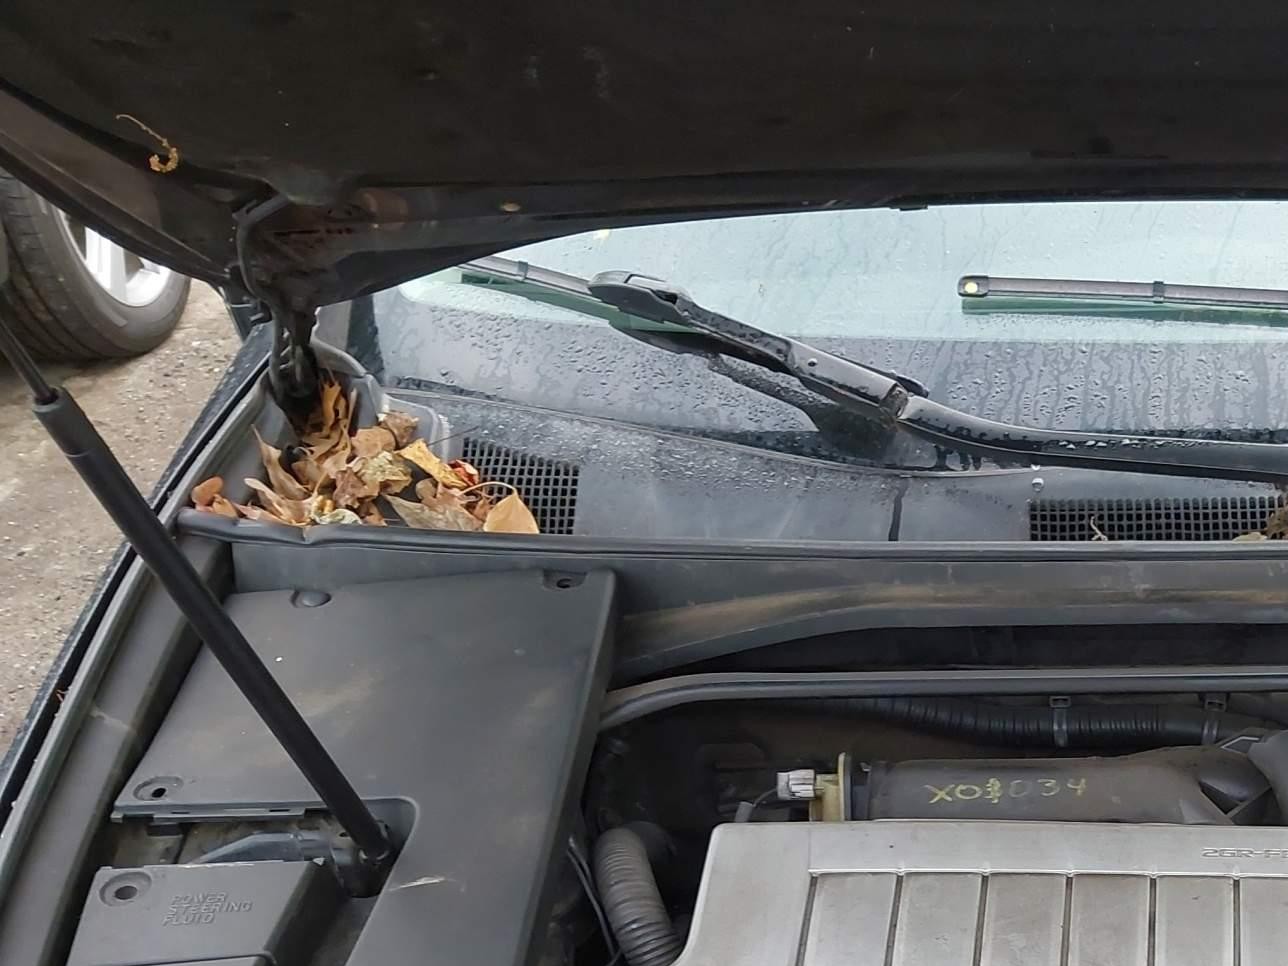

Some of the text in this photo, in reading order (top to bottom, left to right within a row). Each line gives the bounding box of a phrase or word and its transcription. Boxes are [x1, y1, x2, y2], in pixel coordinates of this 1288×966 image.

[169, 892, 228, 905] POWER
[167, 901, 253, 915] STEERING
[162, 912, 216, 926] FLUID
